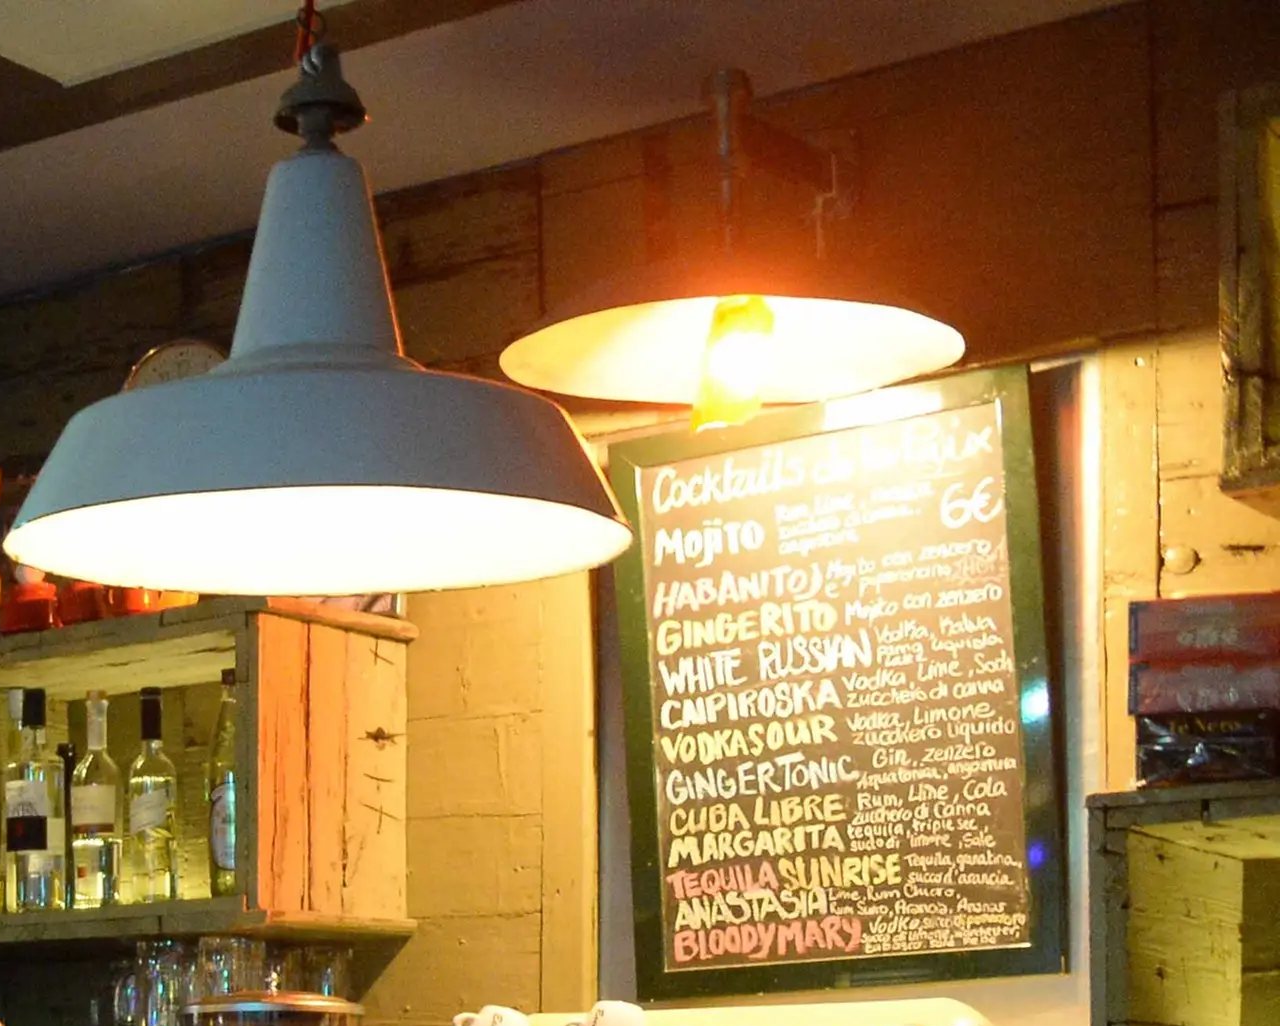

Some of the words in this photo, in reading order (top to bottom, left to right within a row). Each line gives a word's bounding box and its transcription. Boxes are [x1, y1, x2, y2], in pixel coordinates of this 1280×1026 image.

[653, 449, 806, 514] Cocktails
[656, 599, 839, 656] GINGERITO
[658, 648, 748, 697] WHITE
[757, 627, 872, 681] RUSSIAN
[963, 776, 1008, 800] Cola
[670, 803, 751, 836] CUBA
[754, 794, 847, 826] LIBRE
[667, 824, 845, 868] MARGARITA
[666, 860, 779, 900] TEQUILA
[778, 853, 902, 891] SUNRISE
[675, 888, 828, 931] ANASTASIA
